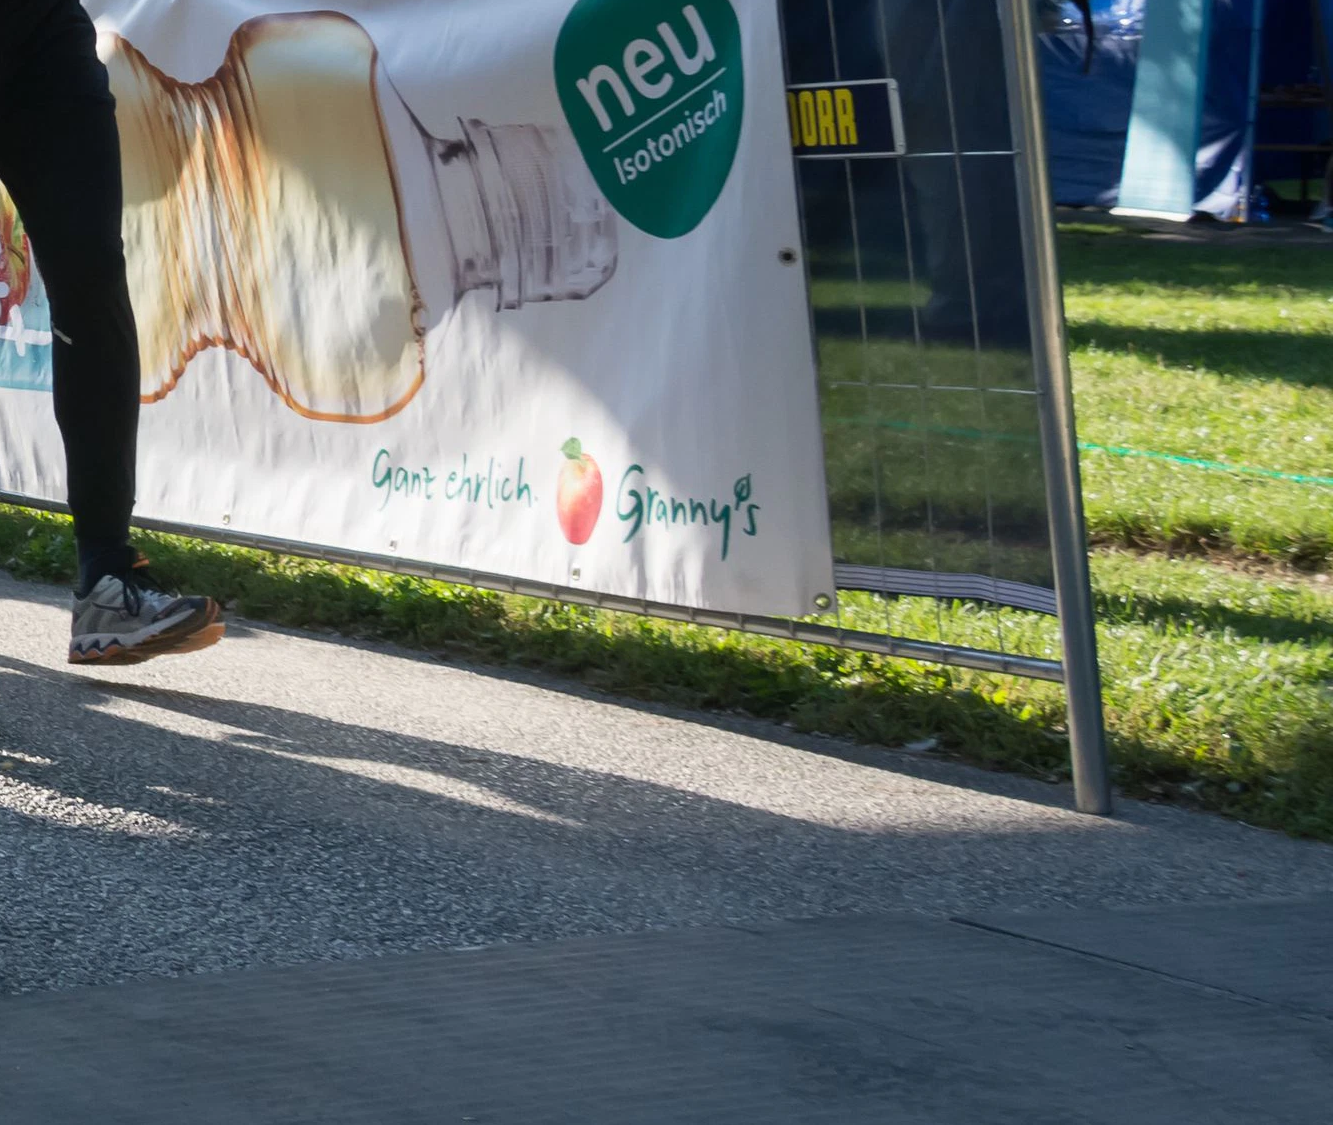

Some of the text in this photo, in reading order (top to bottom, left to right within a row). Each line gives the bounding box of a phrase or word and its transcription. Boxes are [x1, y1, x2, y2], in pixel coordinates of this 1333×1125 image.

[575, 4, 717, 132] neu
[613, 89, 728, 185] Isotonisch
[372, 448, 436, 512] Ganz
